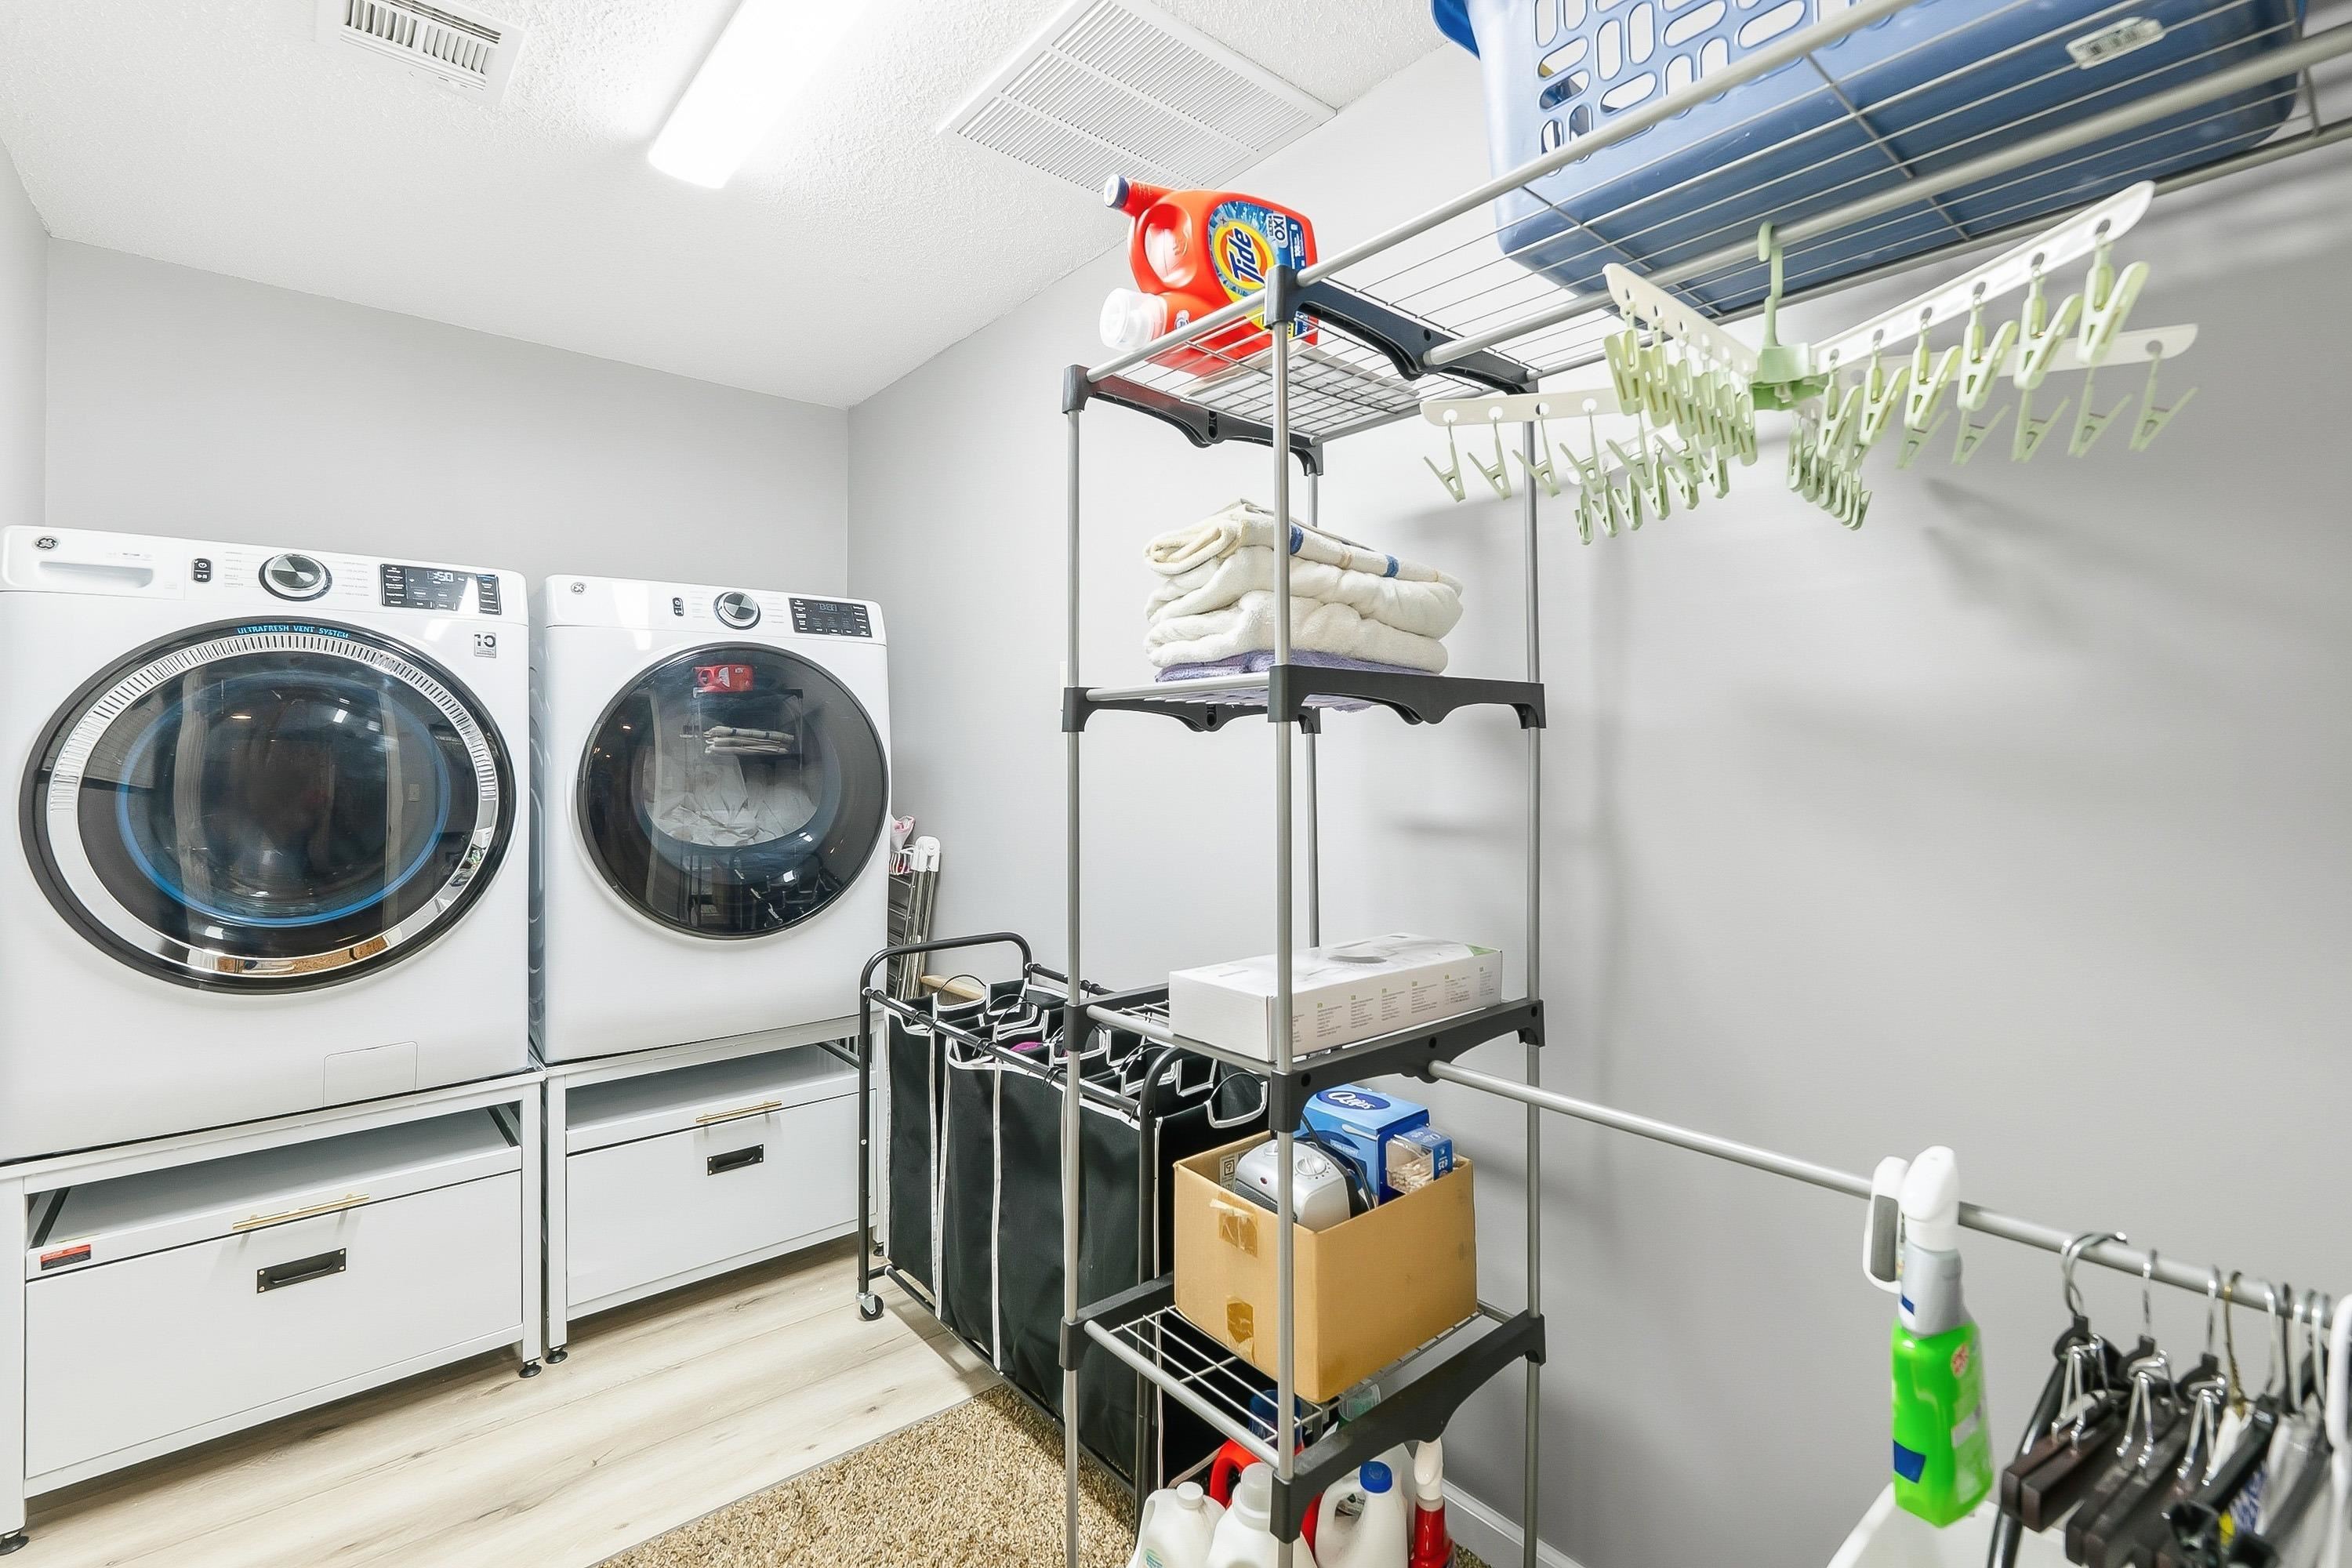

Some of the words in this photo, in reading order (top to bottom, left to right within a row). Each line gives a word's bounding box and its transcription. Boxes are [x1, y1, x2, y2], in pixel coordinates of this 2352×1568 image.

[1273, 216, 1286, 241] OXI
[1227, 227, 1265, 284] Tide
[237, 625, 289, 634] ULTRAFRESH
[318, 628, 350, 638] SYSTEM
